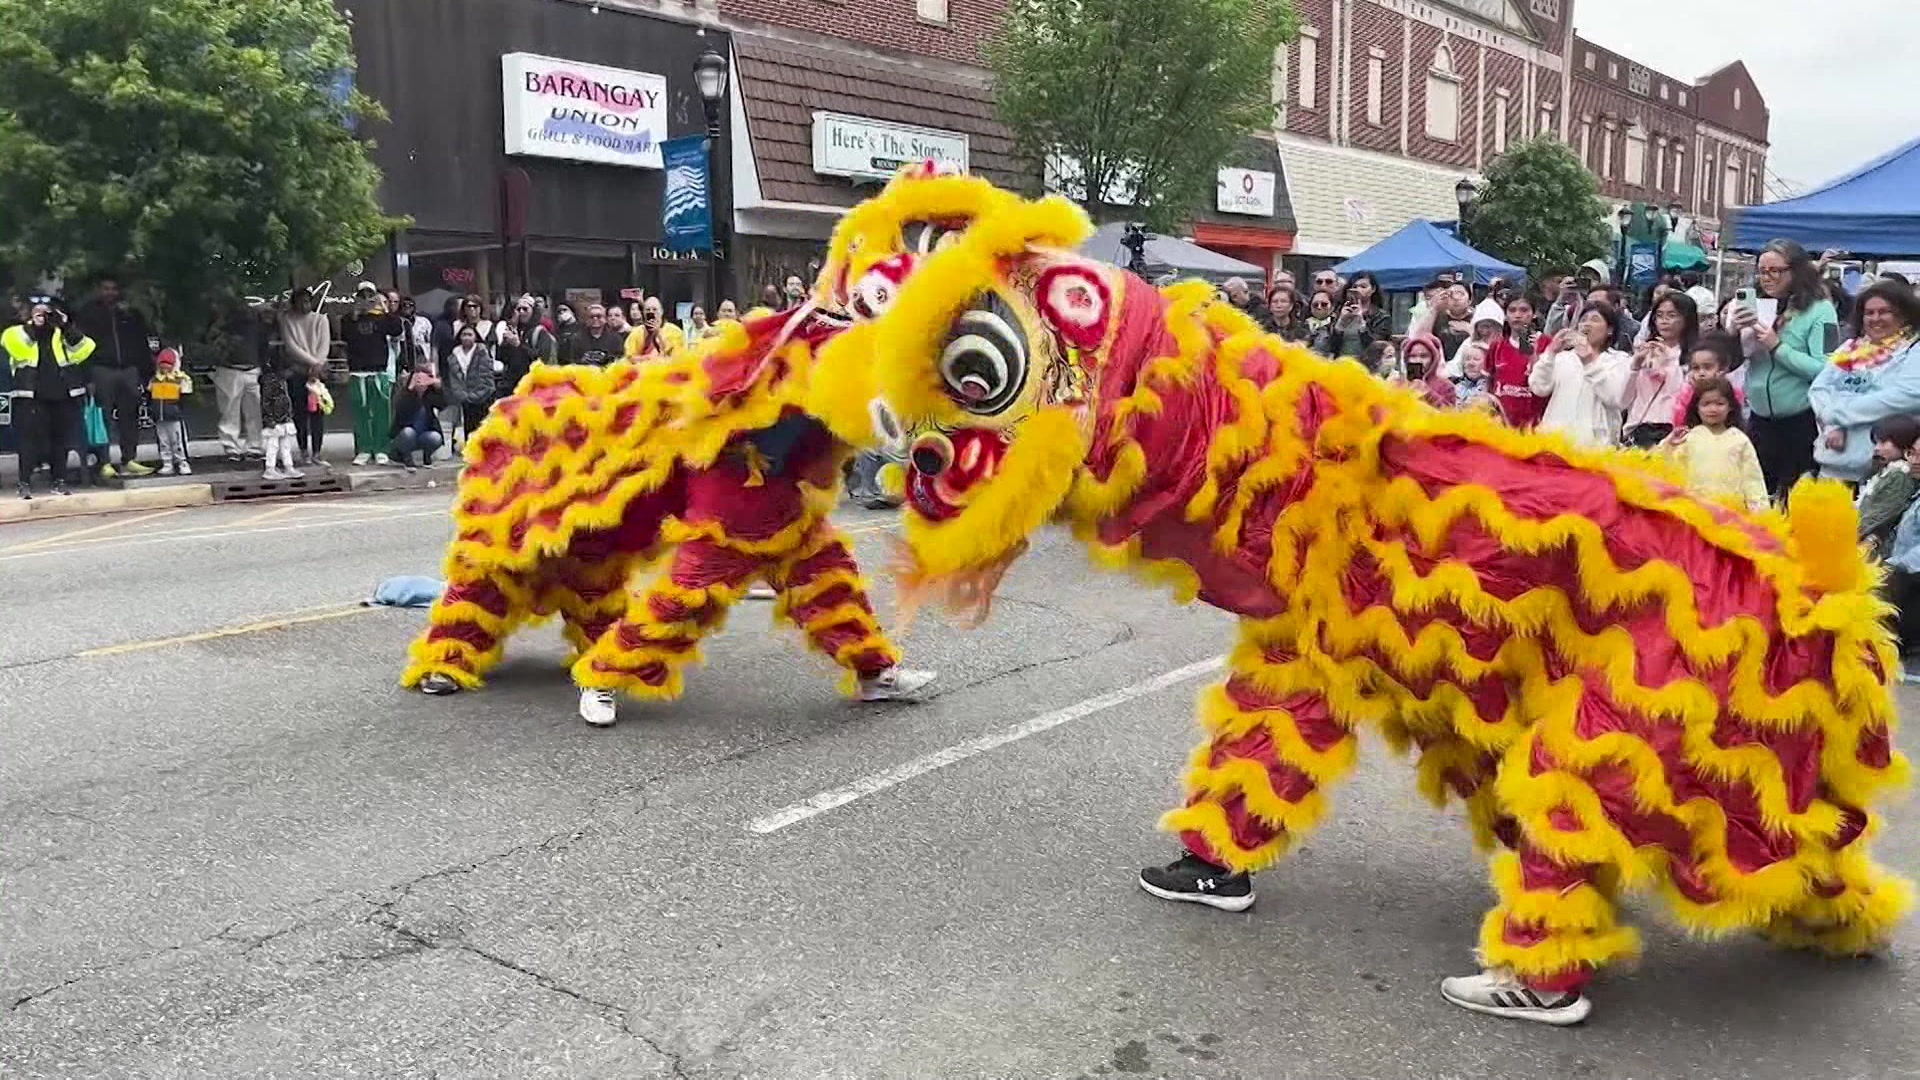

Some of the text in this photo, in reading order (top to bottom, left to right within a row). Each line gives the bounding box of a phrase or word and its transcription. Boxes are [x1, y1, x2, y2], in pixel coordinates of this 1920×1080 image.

[525, 71, 659, 109] BARANGAY
[551, 107, 640, 130] UNION
[571, 133, 583, 145] &
[585, 134, 620, 149] FOOD
[832, 127, 877, 149] Here's
[881, 133, 905, 156] The
